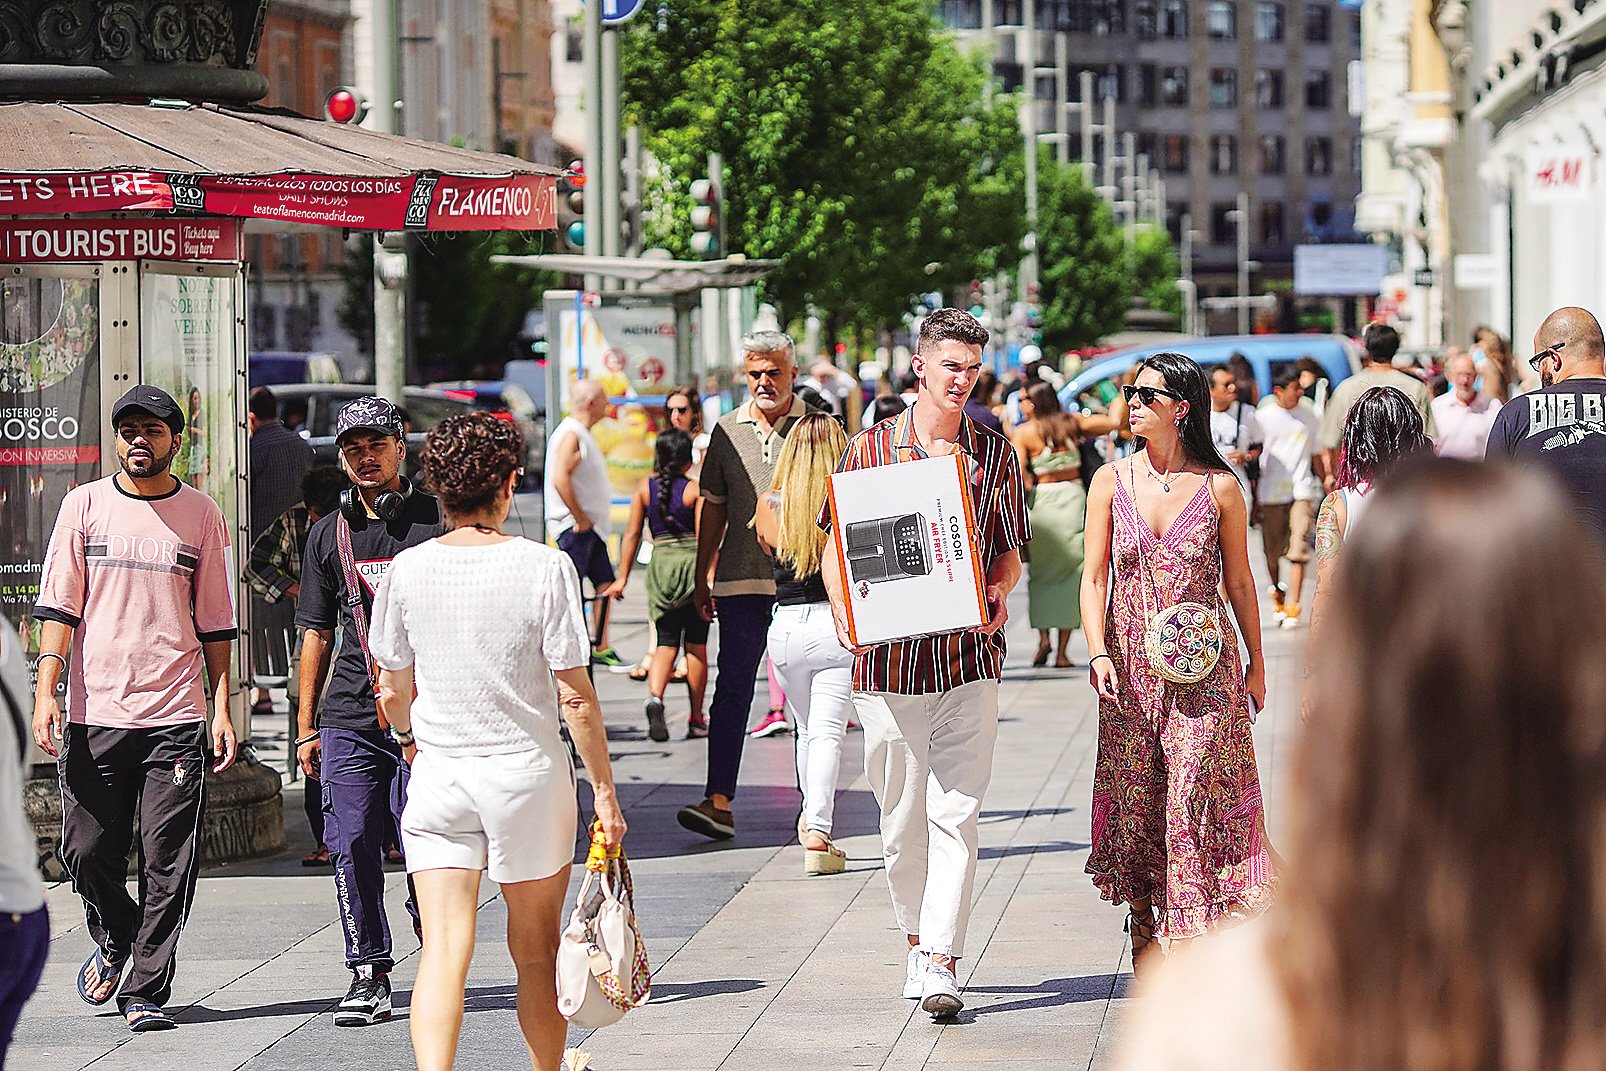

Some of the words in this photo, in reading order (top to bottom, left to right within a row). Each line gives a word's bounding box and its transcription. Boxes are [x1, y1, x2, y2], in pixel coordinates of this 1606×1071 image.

[68, 172, 154, 199] HERE
[176, 186, 201, 199] CO
[309, 180, 349, 193] TODOS
[351, 181, 373, 193] LOS
[375, 179, 402, 194] DÍAS
[310, 194, 348, 207] SHOWS
[437, 187, 532, 216] FLAMENCO
[253, 204, 365, 223] teatroflamencomadrid.com
[409, 204, 426, 218] CO
[183, 225, 207, 239] Tickets
[14, 229, 129, 258] TOURIST
[133, 229, 176, 256] BUS
[183, 240, 199, 258] Buy
[200, 241, 214, 255] here
[0, 407, 42, 418] ISTERIO
[45, 406, 58, 417] DE
[1525, 393, 1576, 439] BIG
[1582, 393, 1606, 423] B
[0, 416, 79, 440] OSCO
[26, 449, 79, 461] INMERSIVA
[931, 521, 939, 536] AIR
[949, 515, 964, 561] COSORI
[107, 534, 178, 566] DIOR
[932, 537, 944, 564] FRYER
[2, 585, 12, 594] EL
[15, 585, 26, 594] 14
